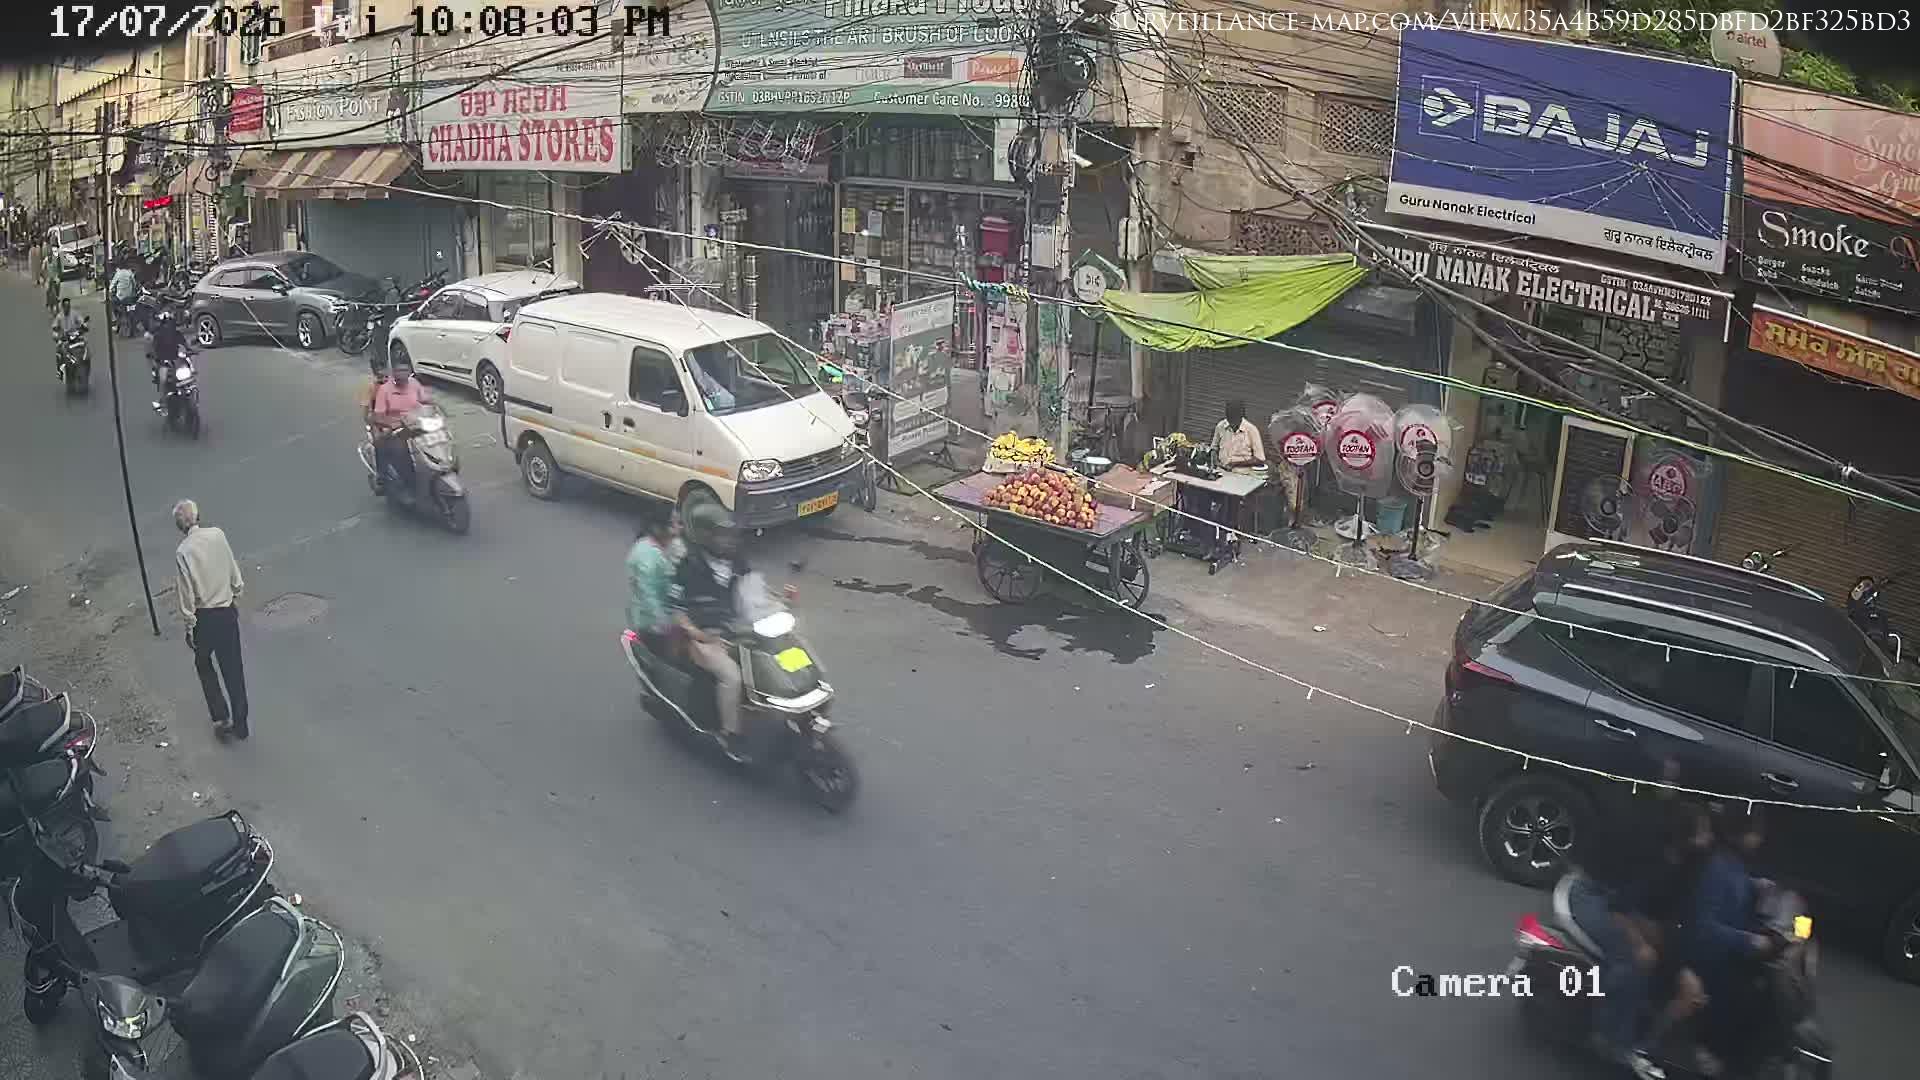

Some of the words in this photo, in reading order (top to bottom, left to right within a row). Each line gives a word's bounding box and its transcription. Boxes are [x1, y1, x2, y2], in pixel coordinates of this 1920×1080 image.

[882, 26, 941, 43] BRUSH
[946, 26, 970, 42] OF
[1736, 33, 1768, 49] airtel
[338, 98, 380, 117] POINT
[874, 92, 930, 105] Customer
[938, 92, 960, 106] Care
[963, 93, 985, 107] No.
[428, 122, 513, 164] CHADHA
[518, 118, 615, 163] STORES
[1484, 95, 1709, 167] BAJAJ
[1399, 194, 1430, 211] Guru
[1432, 198, 1475, 218] Nanak
[1476, 204, 1537, 226] Electrical
[1758, 210, 1870, 258] Smoke
[1436, 255, 1511, 293] NANAK
[1517, 269, 1655, 322] ELECTRICAL
